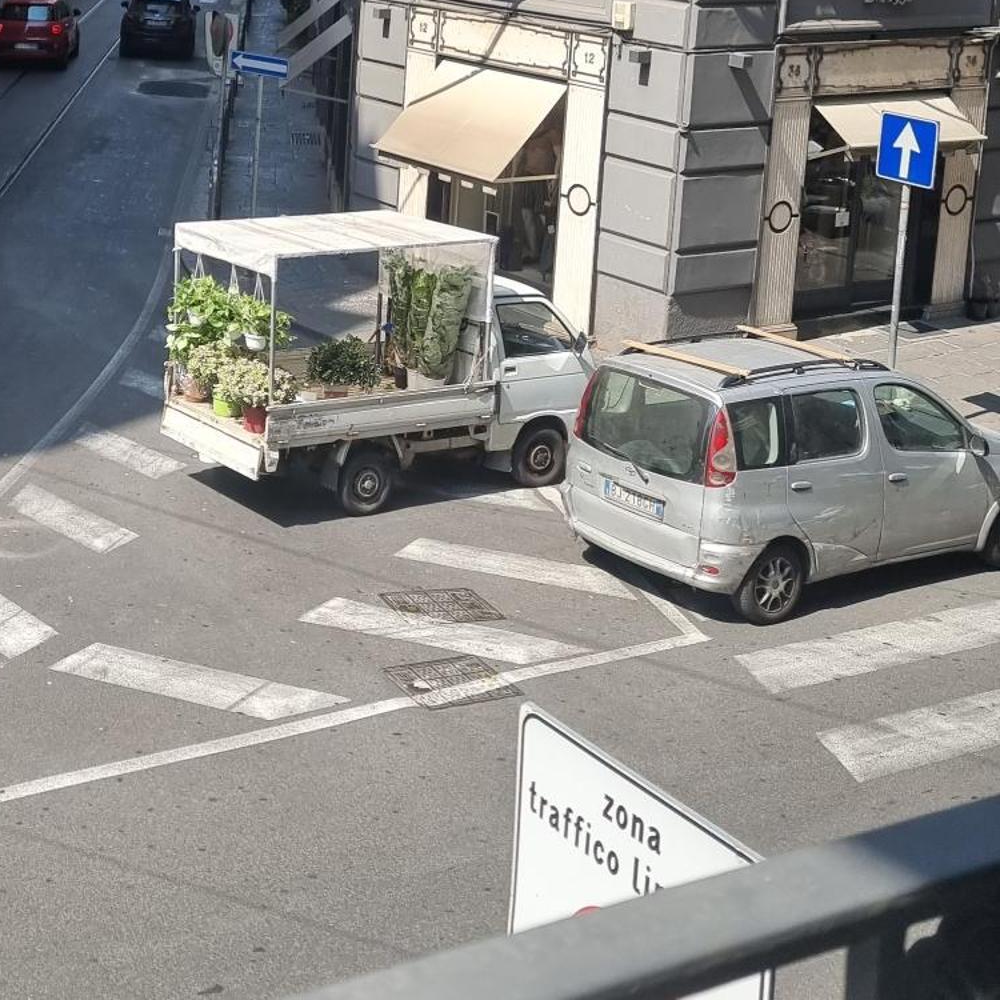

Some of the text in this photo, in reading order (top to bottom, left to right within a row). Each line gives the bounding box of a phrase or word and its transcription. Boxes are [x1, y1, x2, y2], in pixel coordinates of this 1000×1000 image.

[419, 22, 428, 33] 12
[584, 52, 595, 65] 12
[529, 781, 665, 897] traffico li
[602, 793, 661, 856] zona
